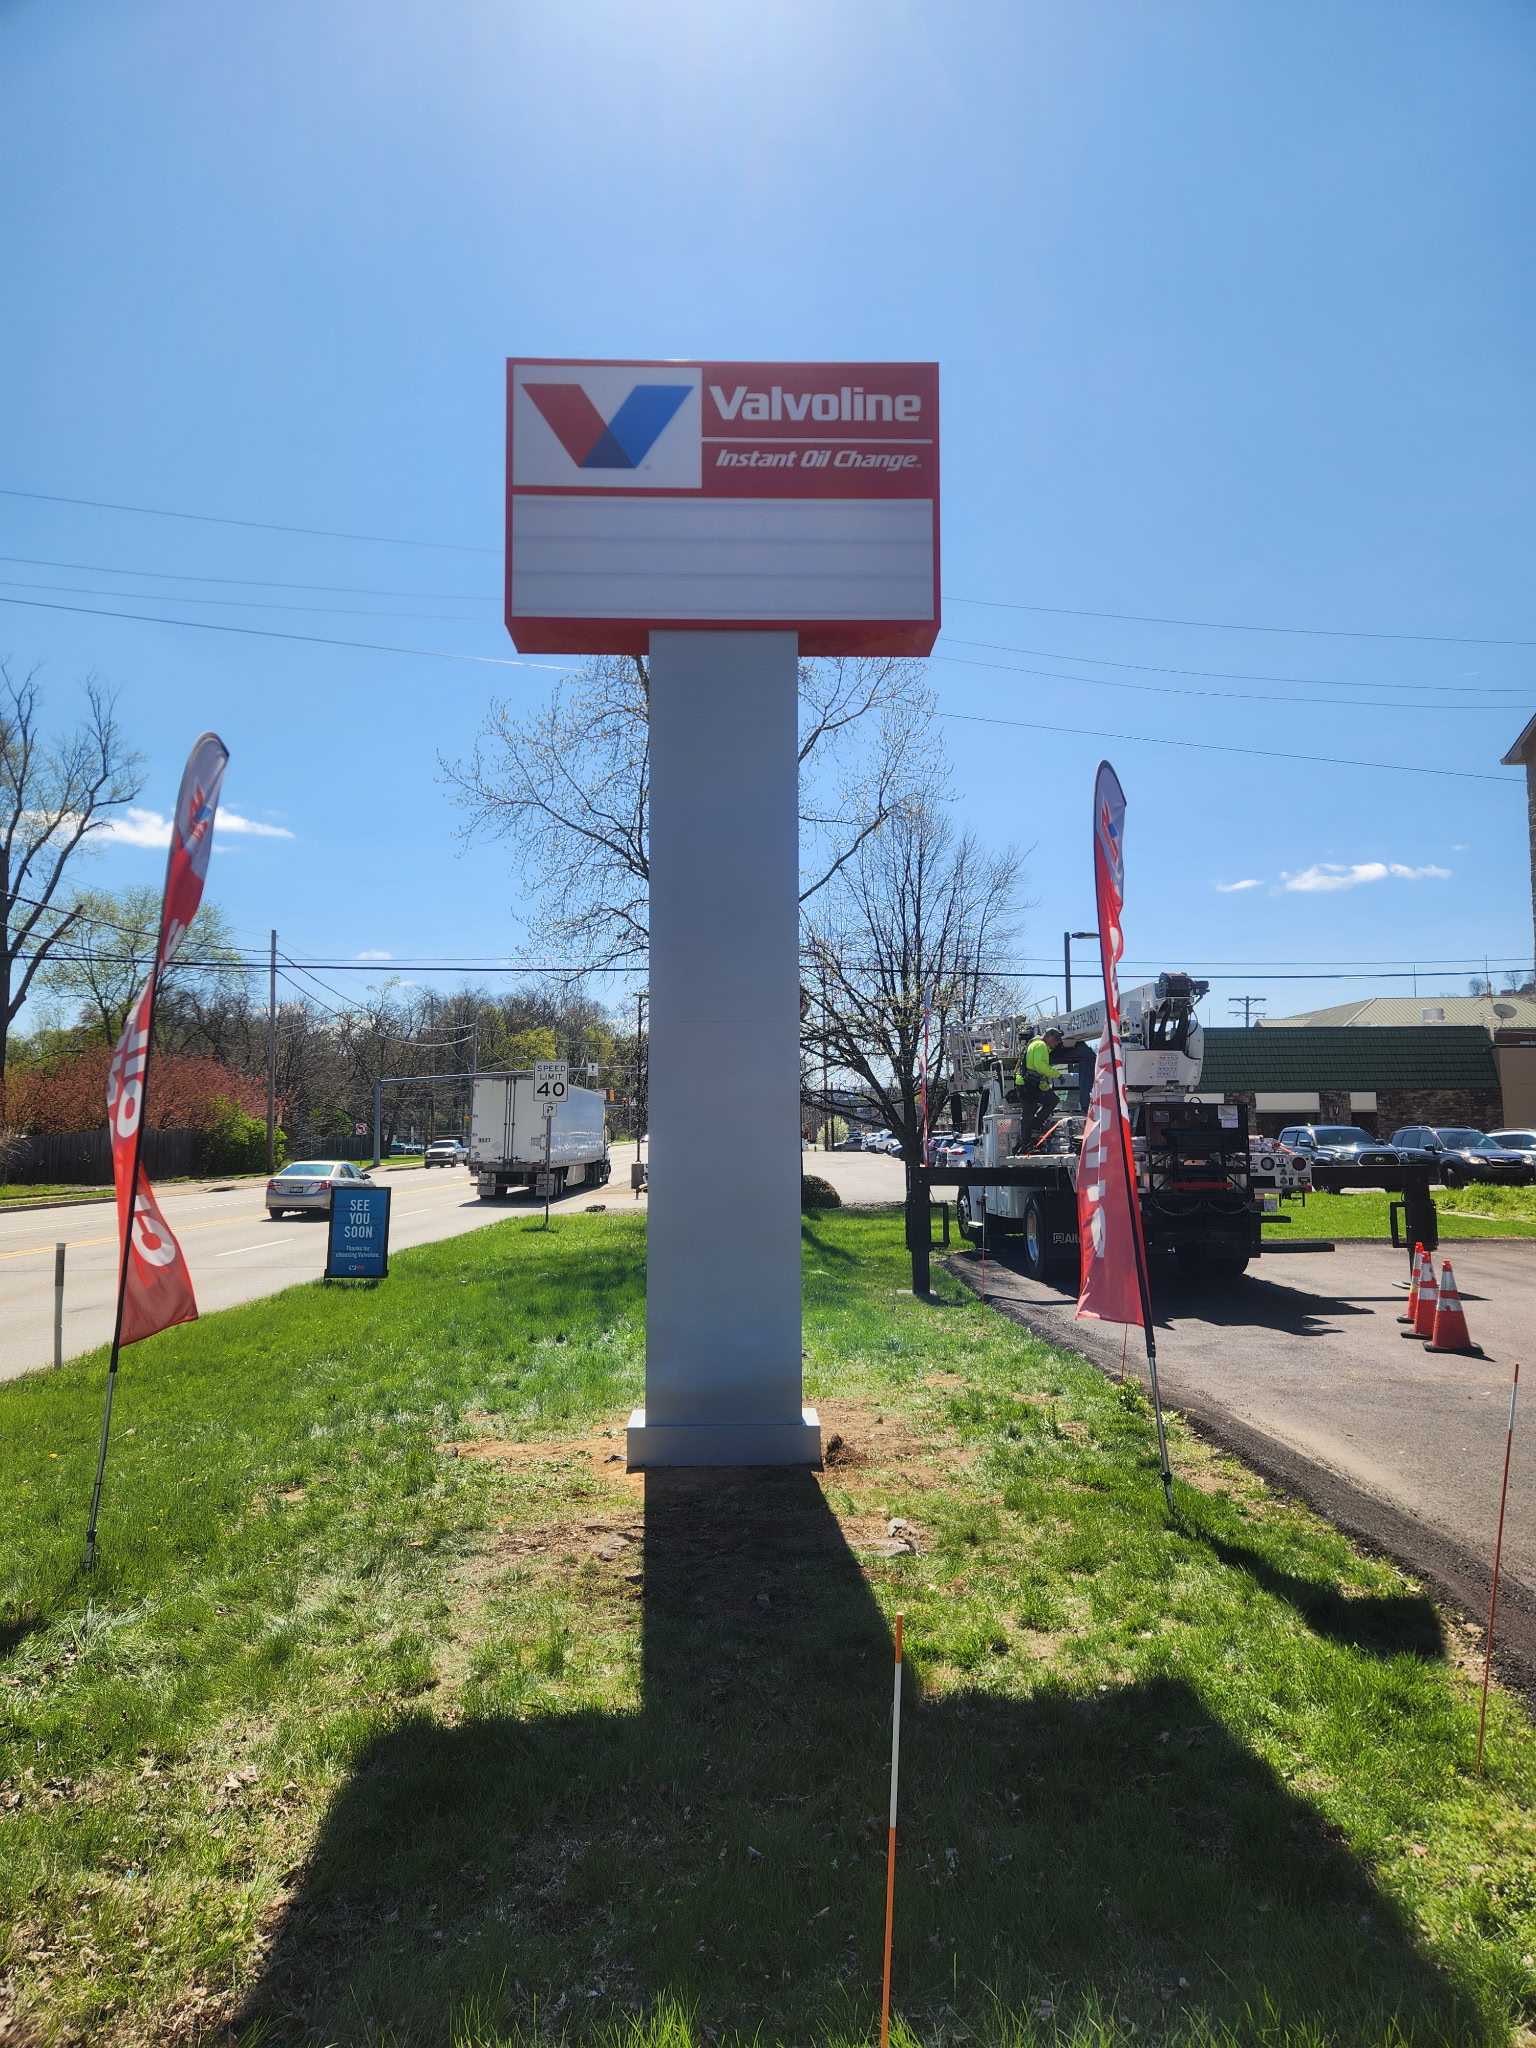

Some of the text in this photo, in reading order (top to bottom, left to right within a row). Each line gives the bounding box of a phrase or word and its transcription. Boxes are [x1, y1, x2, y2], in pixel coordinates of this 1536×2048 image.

[709, 386, 922, 421] Valvoline
[715, 449, 798, 468] Instant
[801, 450, 831, 468] Oil
[537, 1064, 566, 1072] SPEED
[537, 1082, 565, 1097] 40
[350, 1200, 370, 1211] SEE
[350, 1213, 370, 1224] YOU
[344, 1226, 373, 1238] SOON
